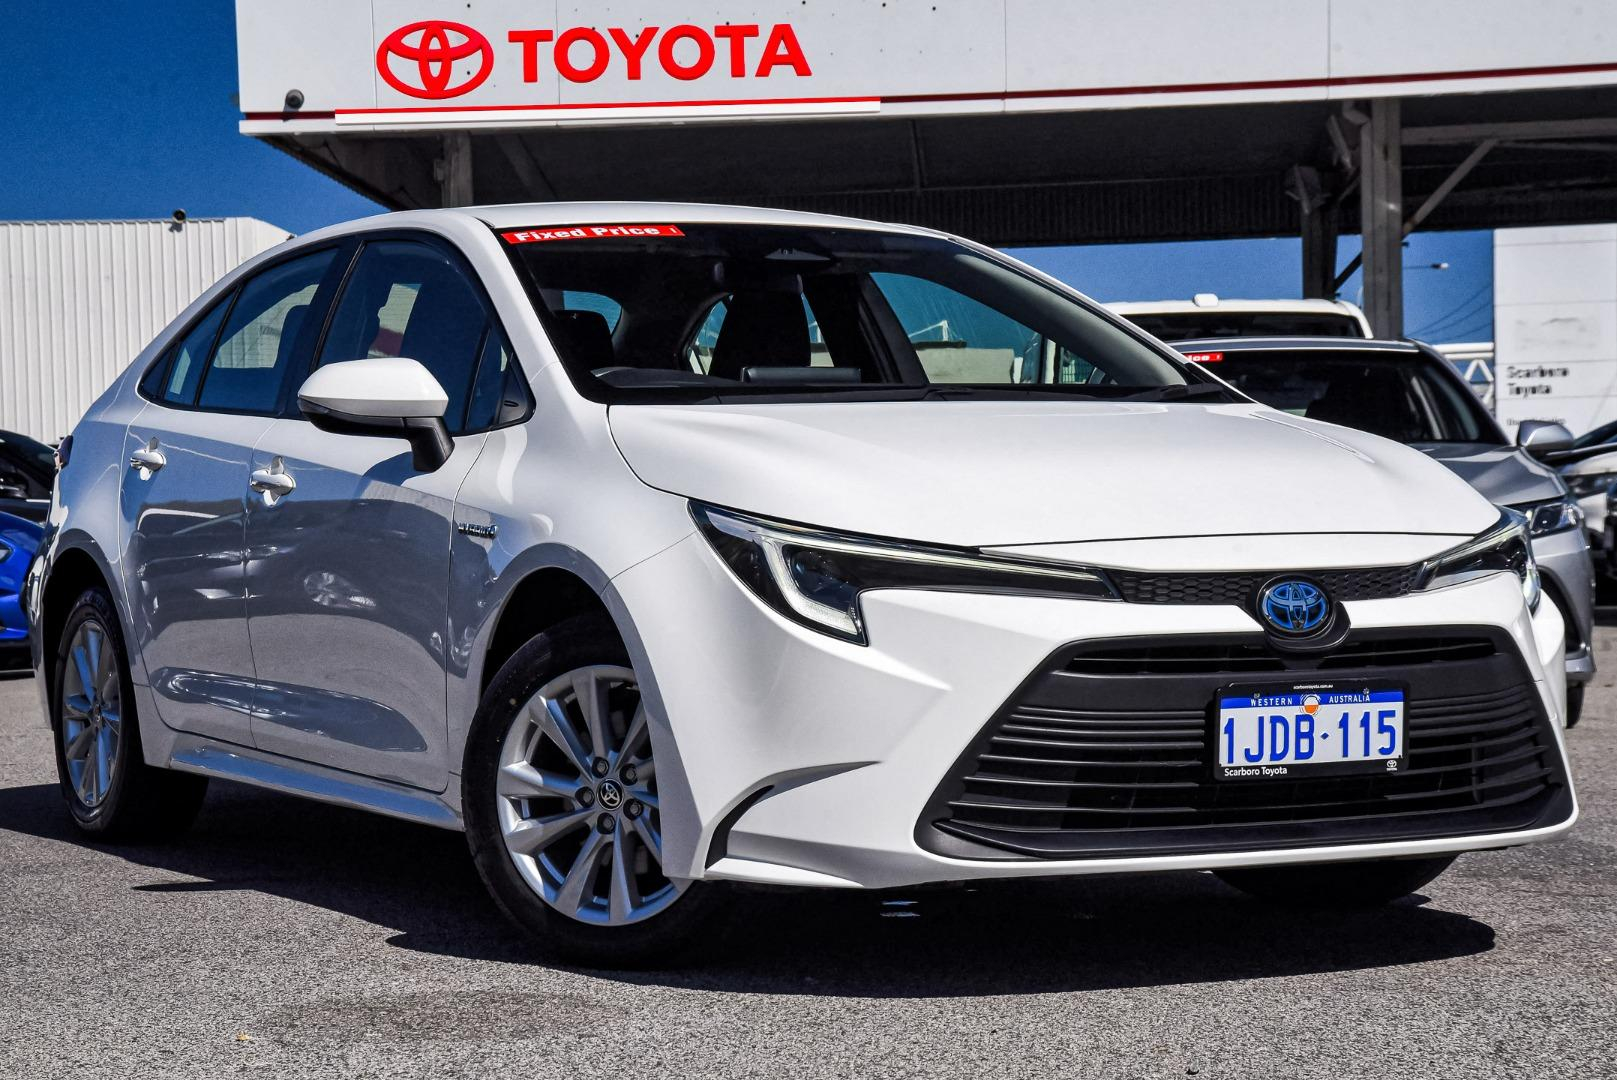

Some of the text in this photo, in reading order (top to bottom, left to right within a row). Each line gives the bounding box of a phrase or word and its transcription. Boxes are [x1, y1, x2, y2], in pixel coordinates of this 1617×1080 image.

[508, 24, 812, 83] TOYOTA
[514, 226, 660, 242] Fixed Price
[1507, 383, 1551, 399] Toyota
[1250, 695, 1370, 706] WESTERN AUSTRALIA
[1224, 766, 1288, 777] Scarboro Toyota
